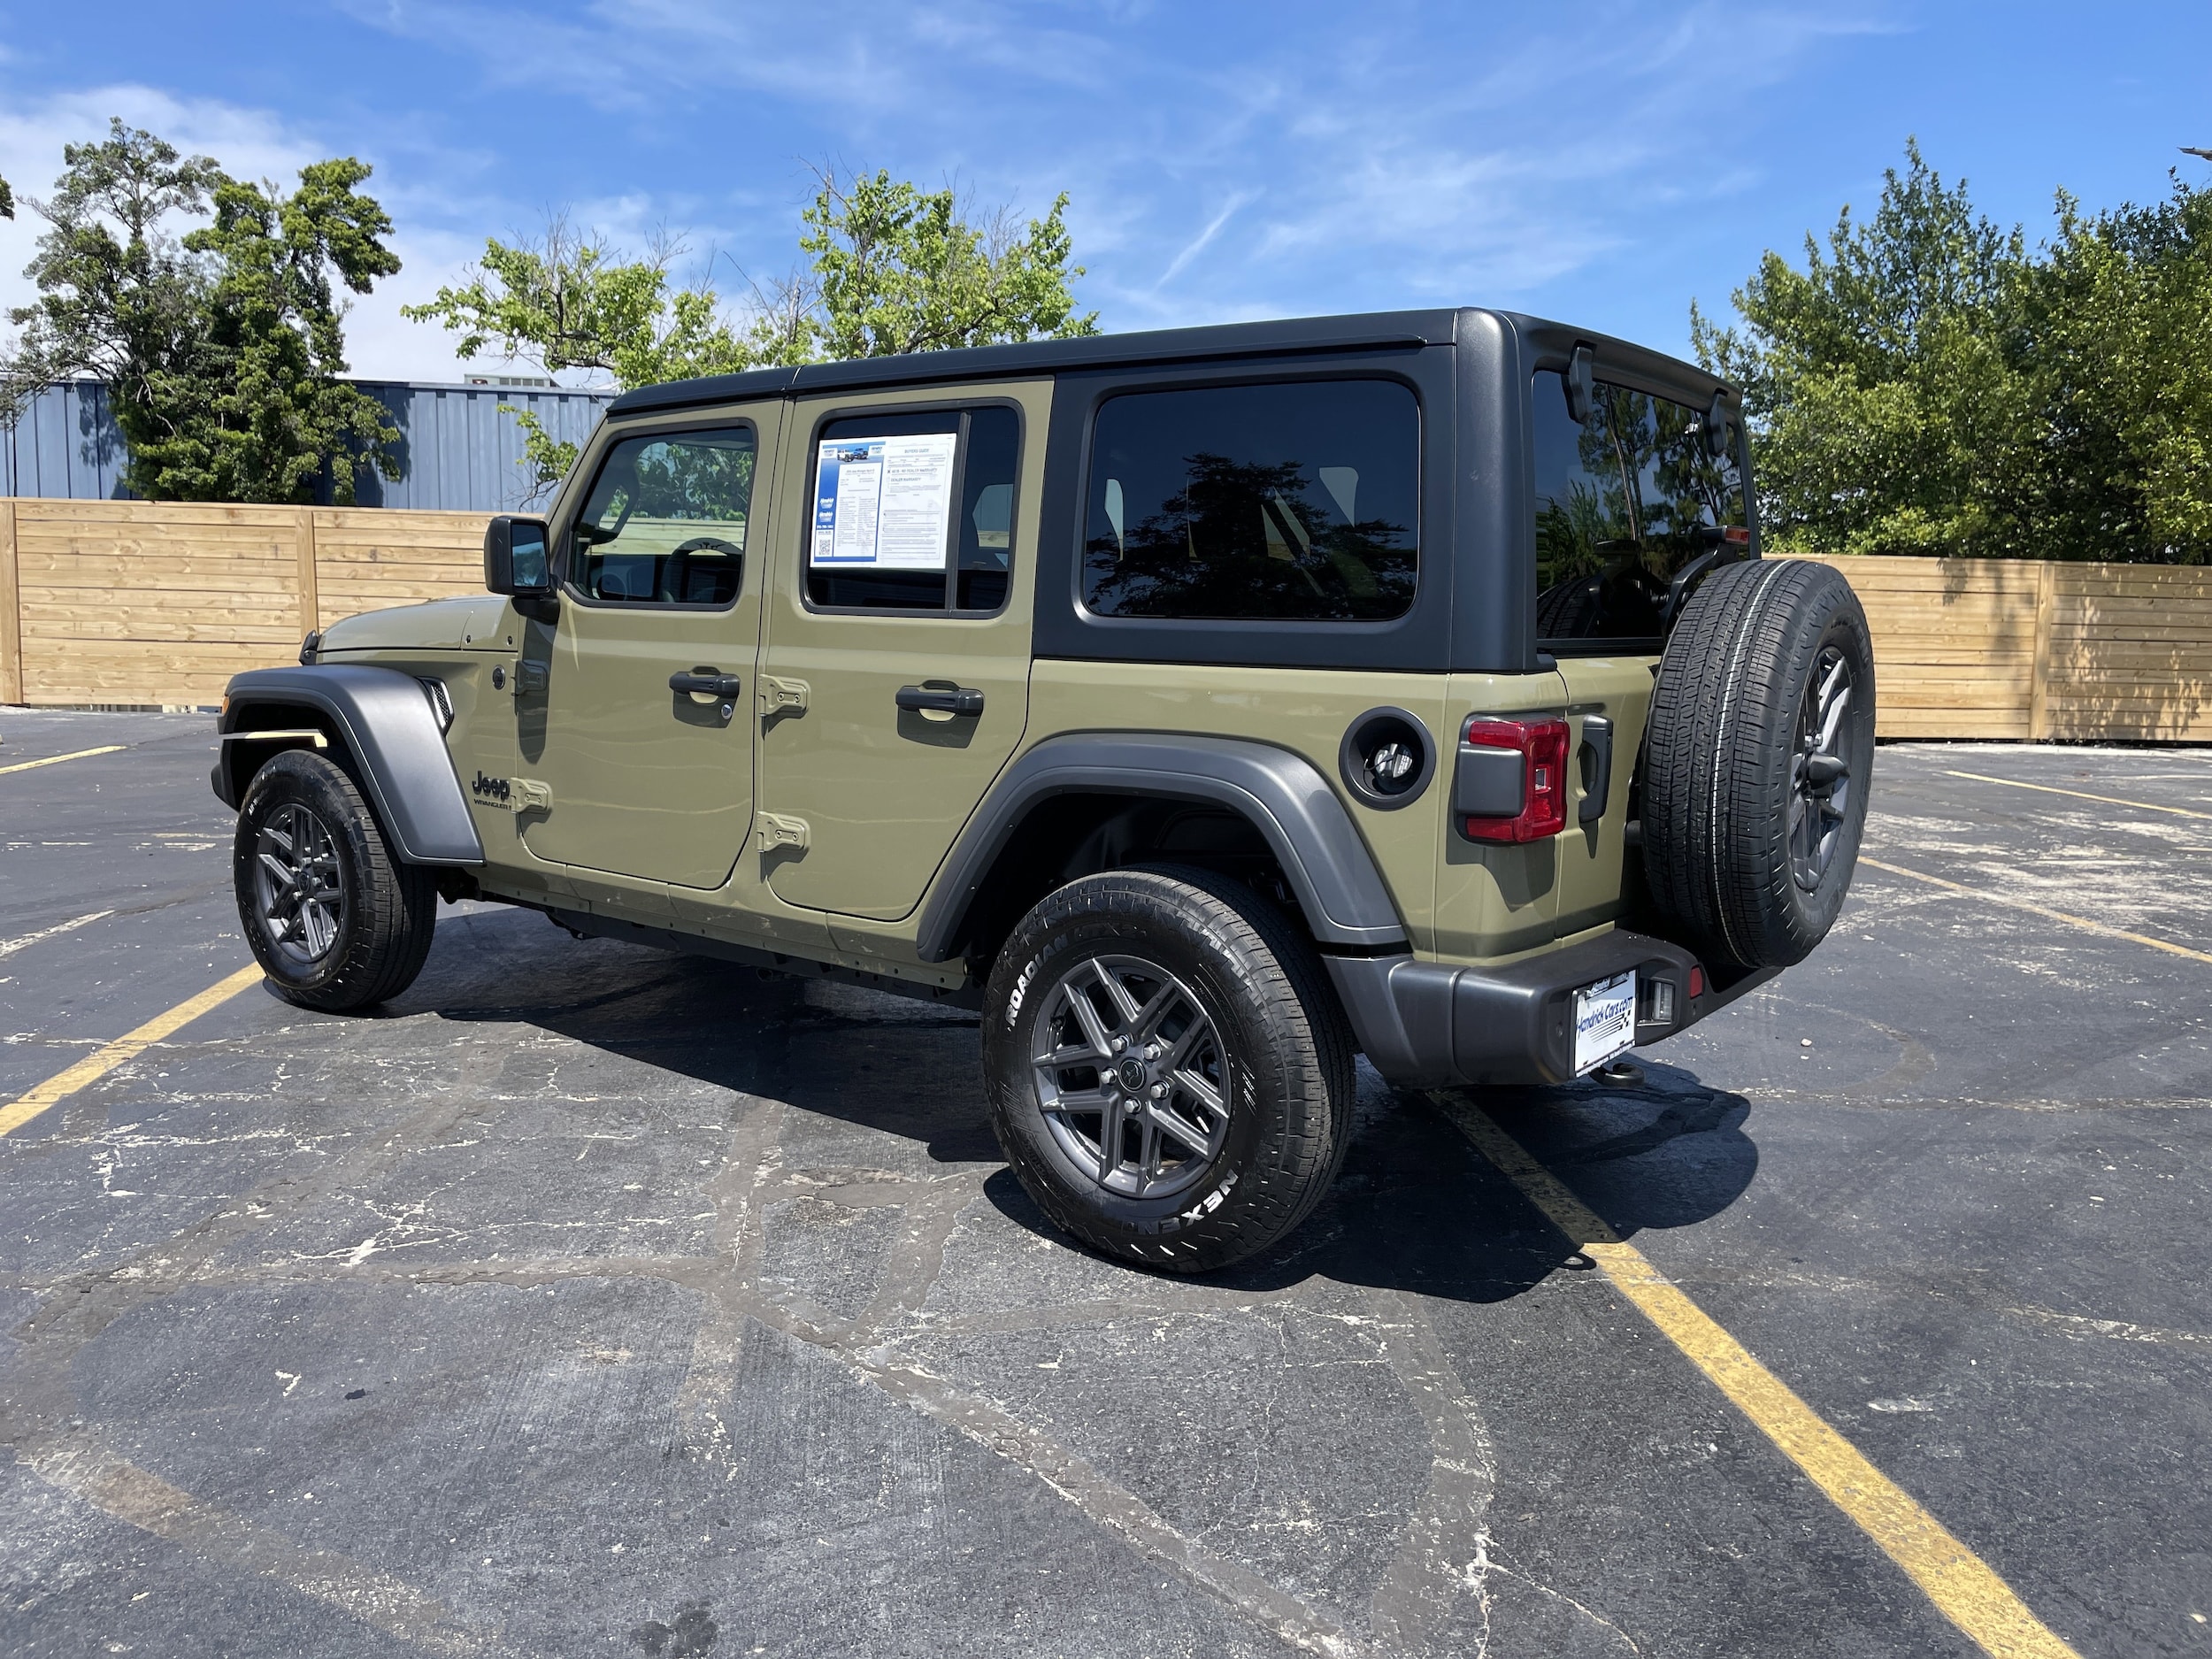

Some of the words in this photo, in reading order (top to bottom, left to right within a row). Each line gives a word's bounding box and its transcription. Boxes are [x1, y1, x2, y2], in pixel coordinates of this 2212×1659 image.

[472, 770, 511, 803] Jeep
[473, 798, 508, 810] WRANGLER
[1005, 933, 1069, 1027] ROADIAN
[1137, 1168, 1240, 1236] NEXEN
